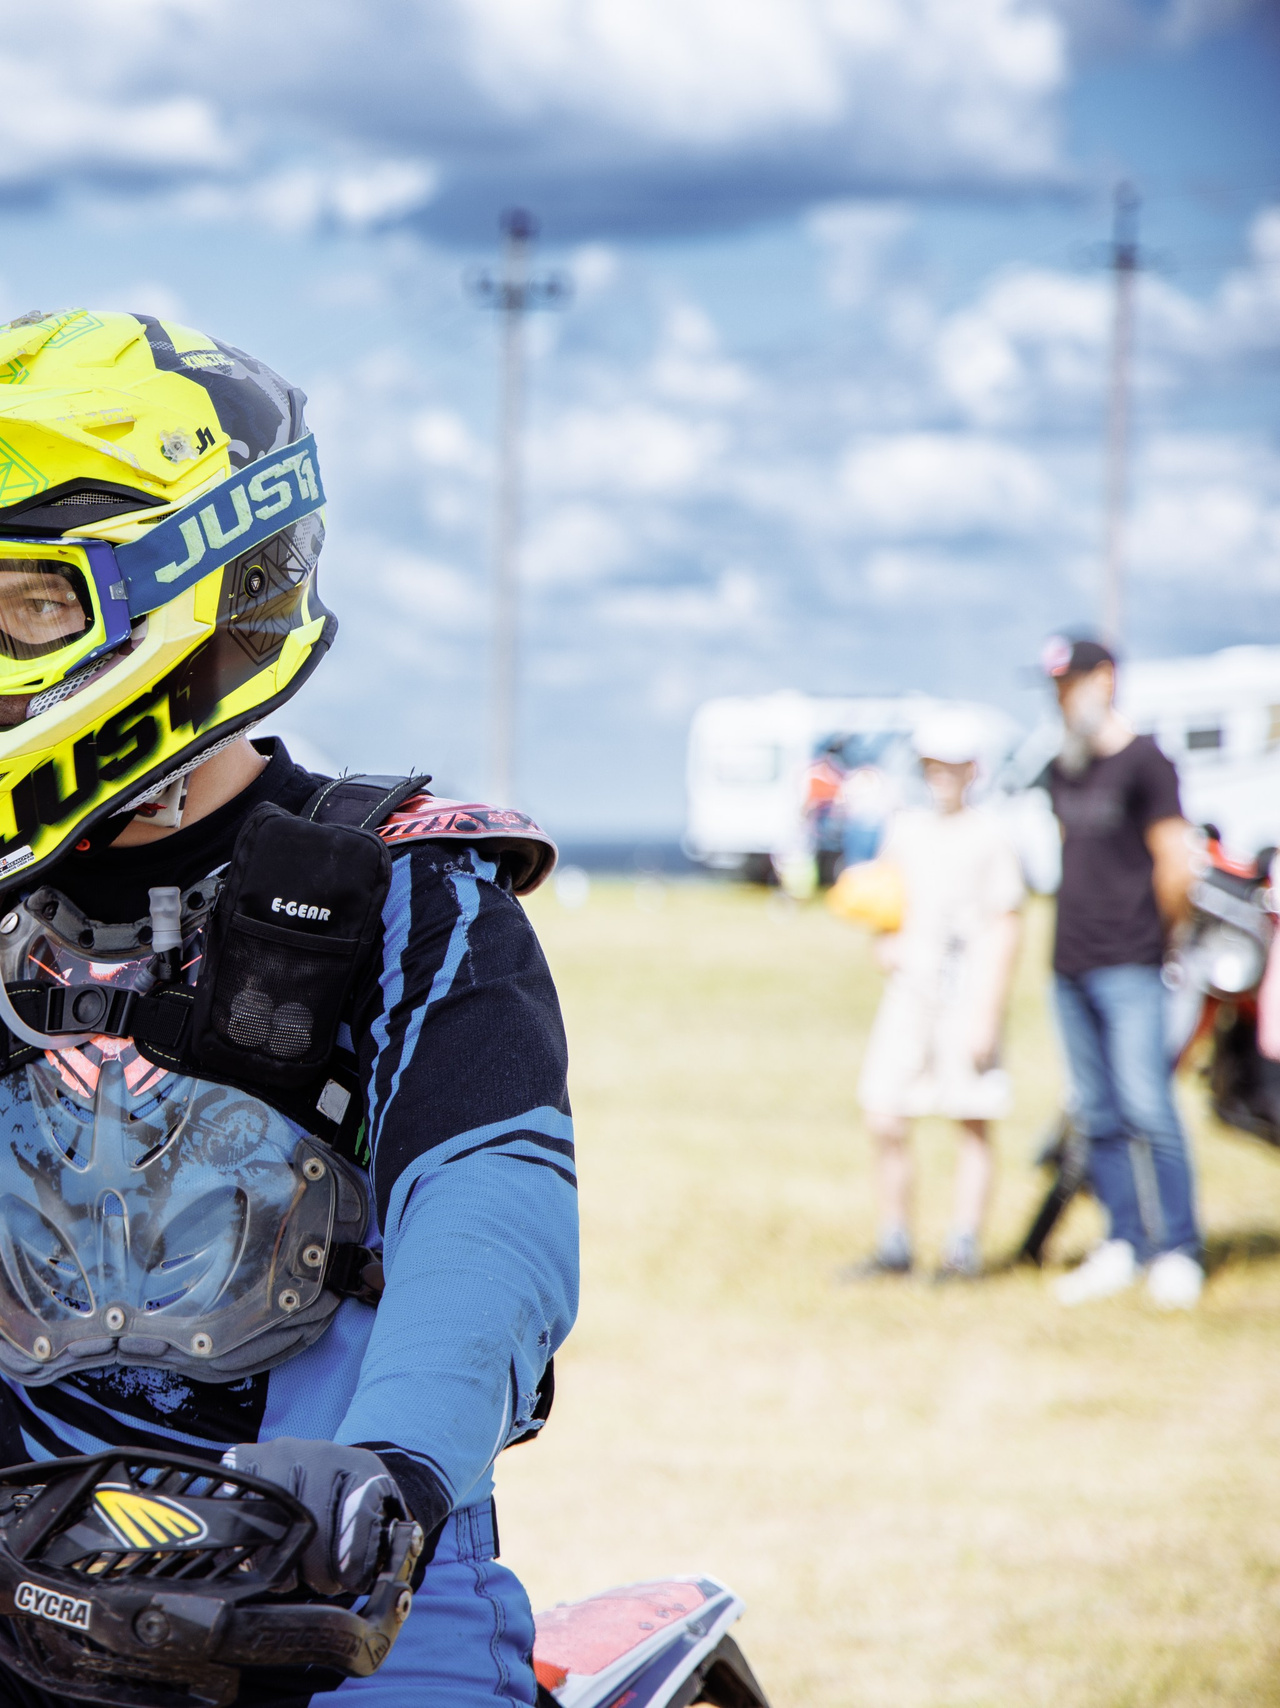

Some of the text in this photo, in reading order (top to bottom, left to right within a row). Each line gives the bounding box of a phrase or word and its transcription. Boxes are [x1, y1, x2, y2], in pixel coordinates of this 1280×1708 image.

[154, 449, 320, 583] JUST1
[271, 897, 331, 921] E-GEAR
[15, 1582, 92, 1630] CYCRA
